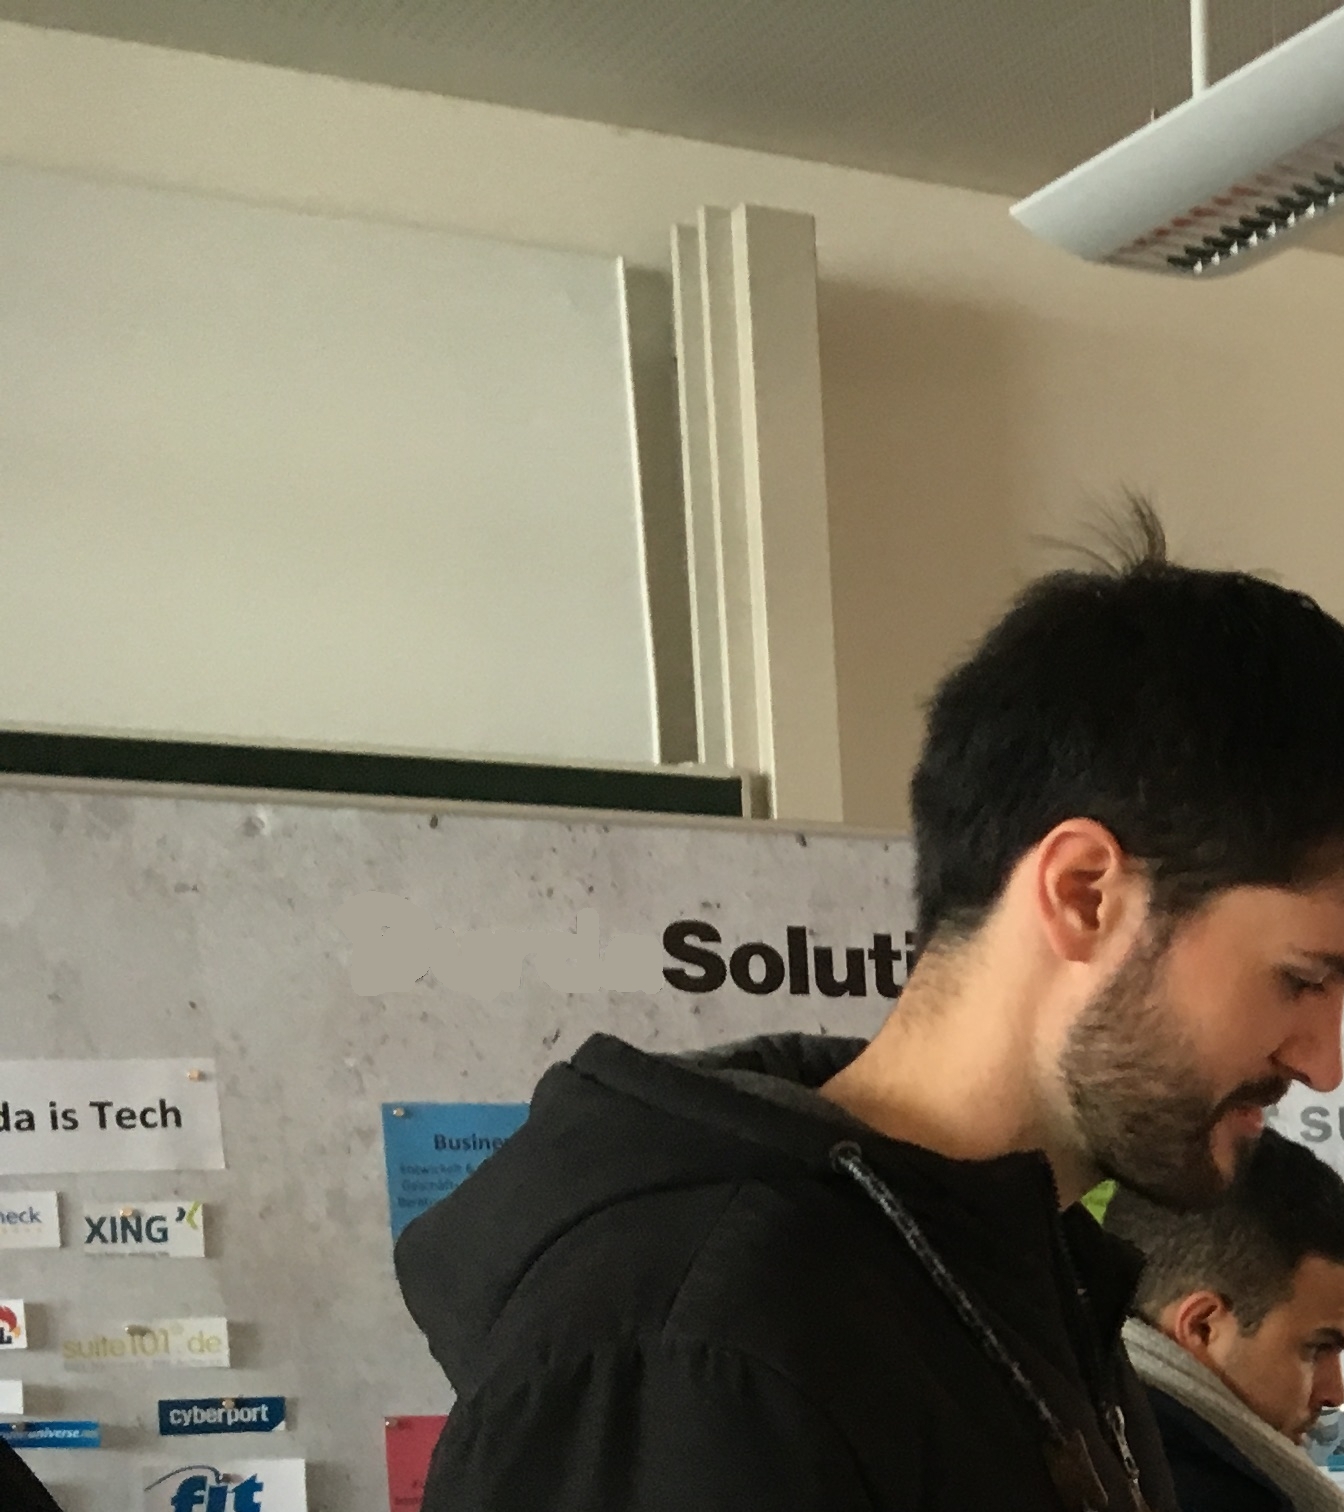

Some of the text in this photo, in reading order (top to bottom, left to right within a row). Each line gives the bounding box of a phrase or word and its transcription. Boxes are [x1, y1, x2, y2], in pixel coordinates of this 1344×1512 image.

[49, 1101, 79, 1130] is
[89, 1098, 183, 1130] Tech
[433, 1133, 510, 1151] Busine
[84, 1214, 169, 1244] XING
[168, 1403, 269, 1426] cyberport
